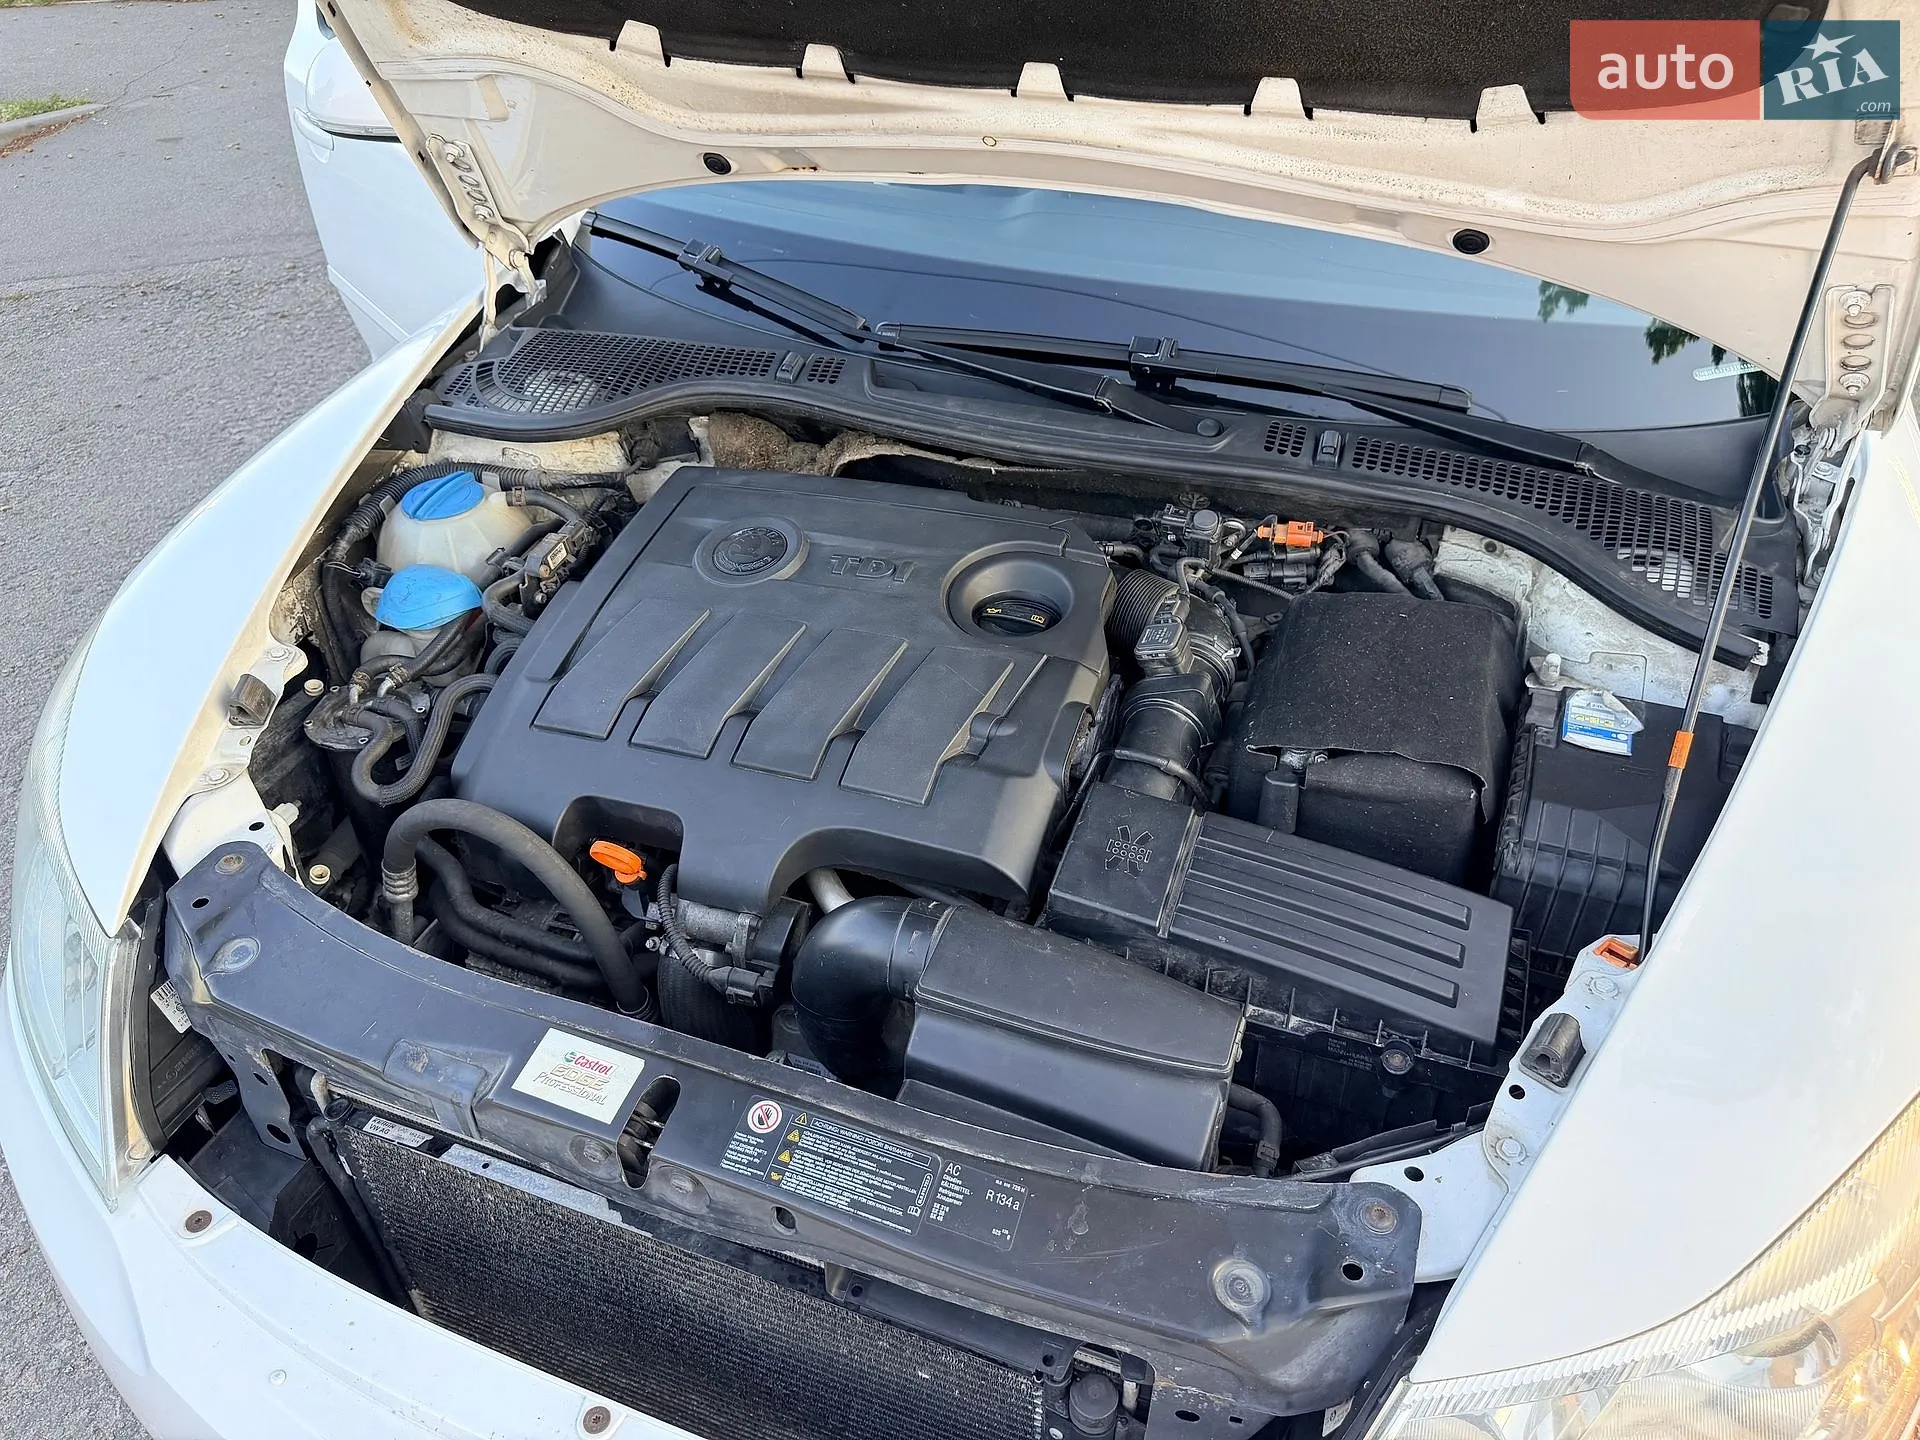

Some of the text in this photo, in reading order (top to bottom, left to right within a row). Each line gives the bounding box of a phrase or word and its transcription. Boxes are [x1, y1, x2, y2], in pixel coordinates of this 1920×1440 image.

[831, 554, 918, 584] TDI
[574, 1055, 613, 1075] Castrol
[550, 1064, 610, 1091] EDGE
[945, 1162, 961, 1176] AC
